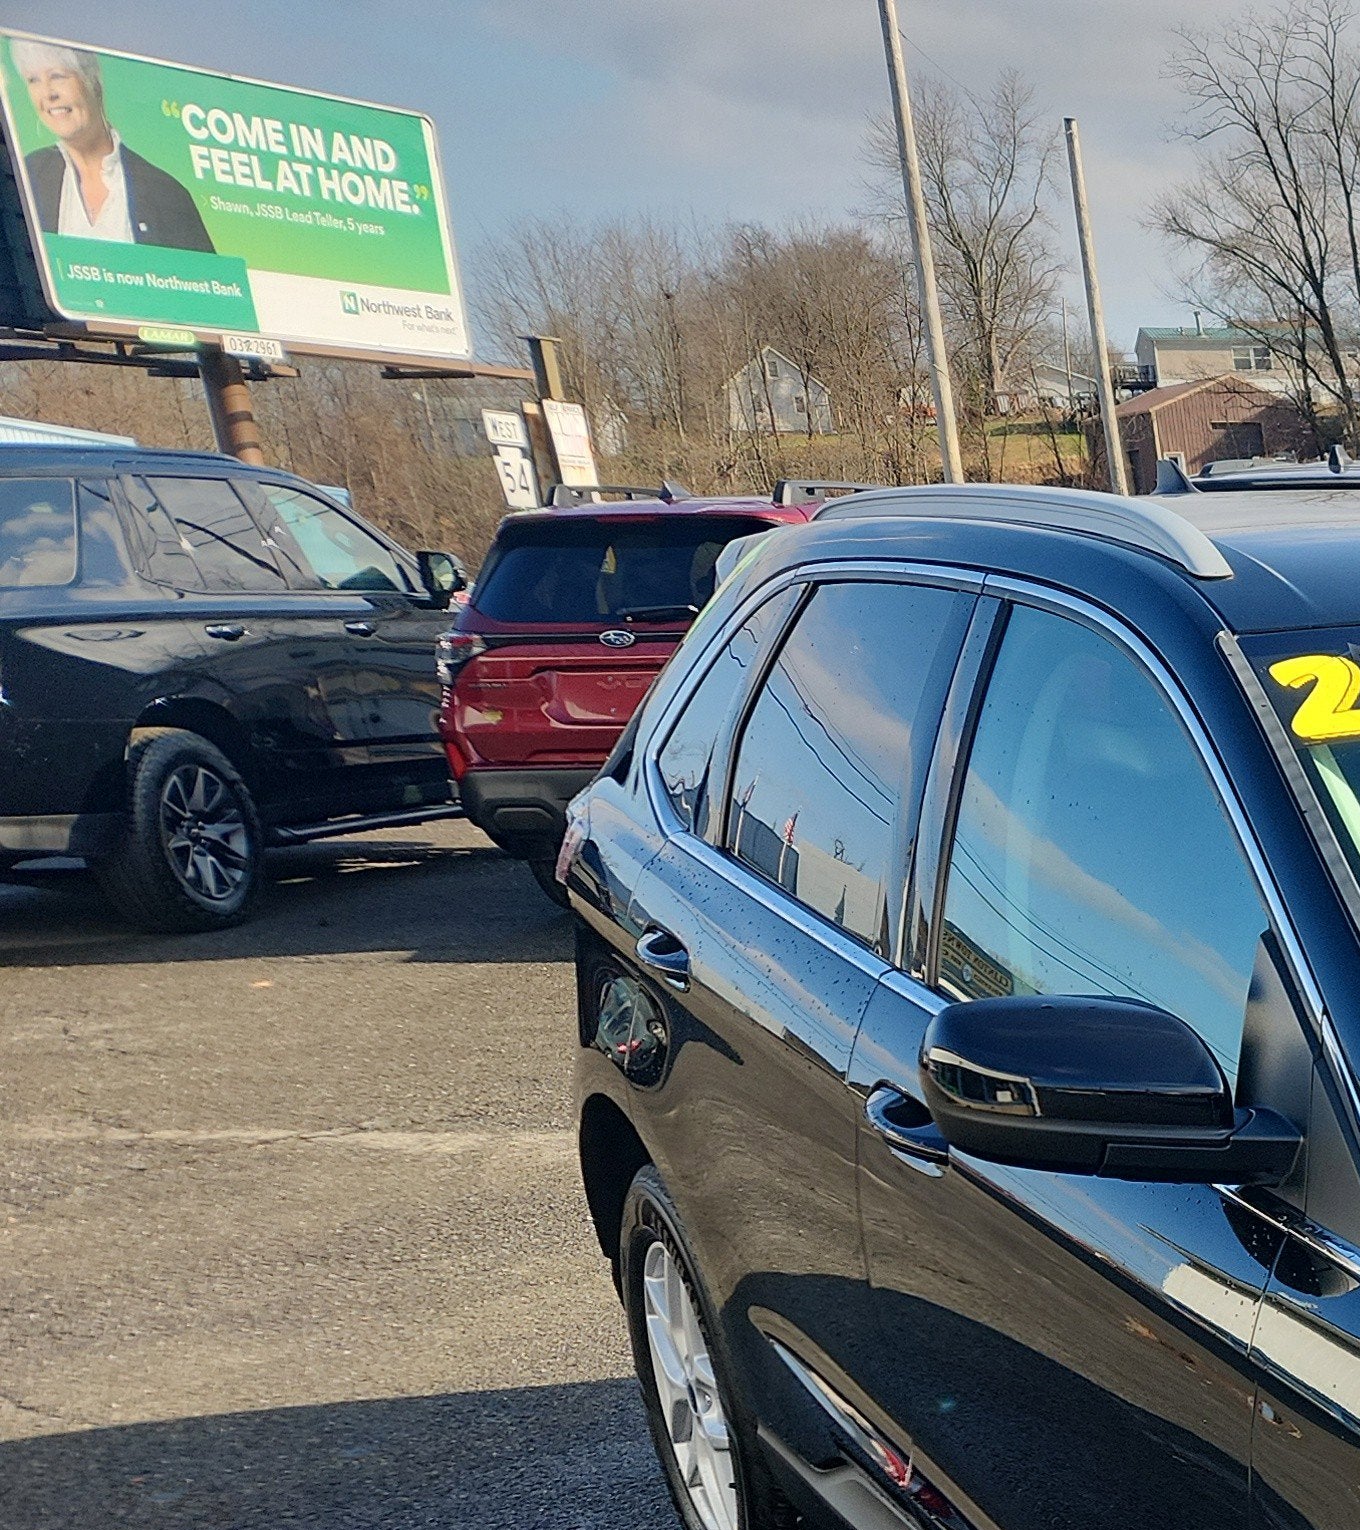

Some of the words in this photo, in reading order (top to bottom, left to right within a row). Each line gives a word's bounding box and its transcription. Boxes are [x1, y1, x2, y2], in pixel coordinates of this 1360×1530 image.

[289, 123, 327, 161] IN
[331, 132, 396, 173] AND
[189, 144, 274, 191] FEEL
[277, 159, 313, 197] AT
[210, 195, 254, 217] Shawn,
[255, 203, 284, 219] JSSB
[285, 207, 312, 224] Lead
[347, 217, 355, 230] 5
[356, 222, 385, 235] years
[67, 264, 102, 281] JSSB
[103, 268, 115, 283] is
[117, 272, 145, 285] now
[146, 273, 210, 294] Northwest
[212, 280, 243, 297] Bank
[360, 297, 423, 319] Northwest
[425, 305, 454, 322] Bank
[143, 328, 190, 342] LAMAR
[488, 416, 518, 439] WEST
[501, 460, 530, 494] 54
